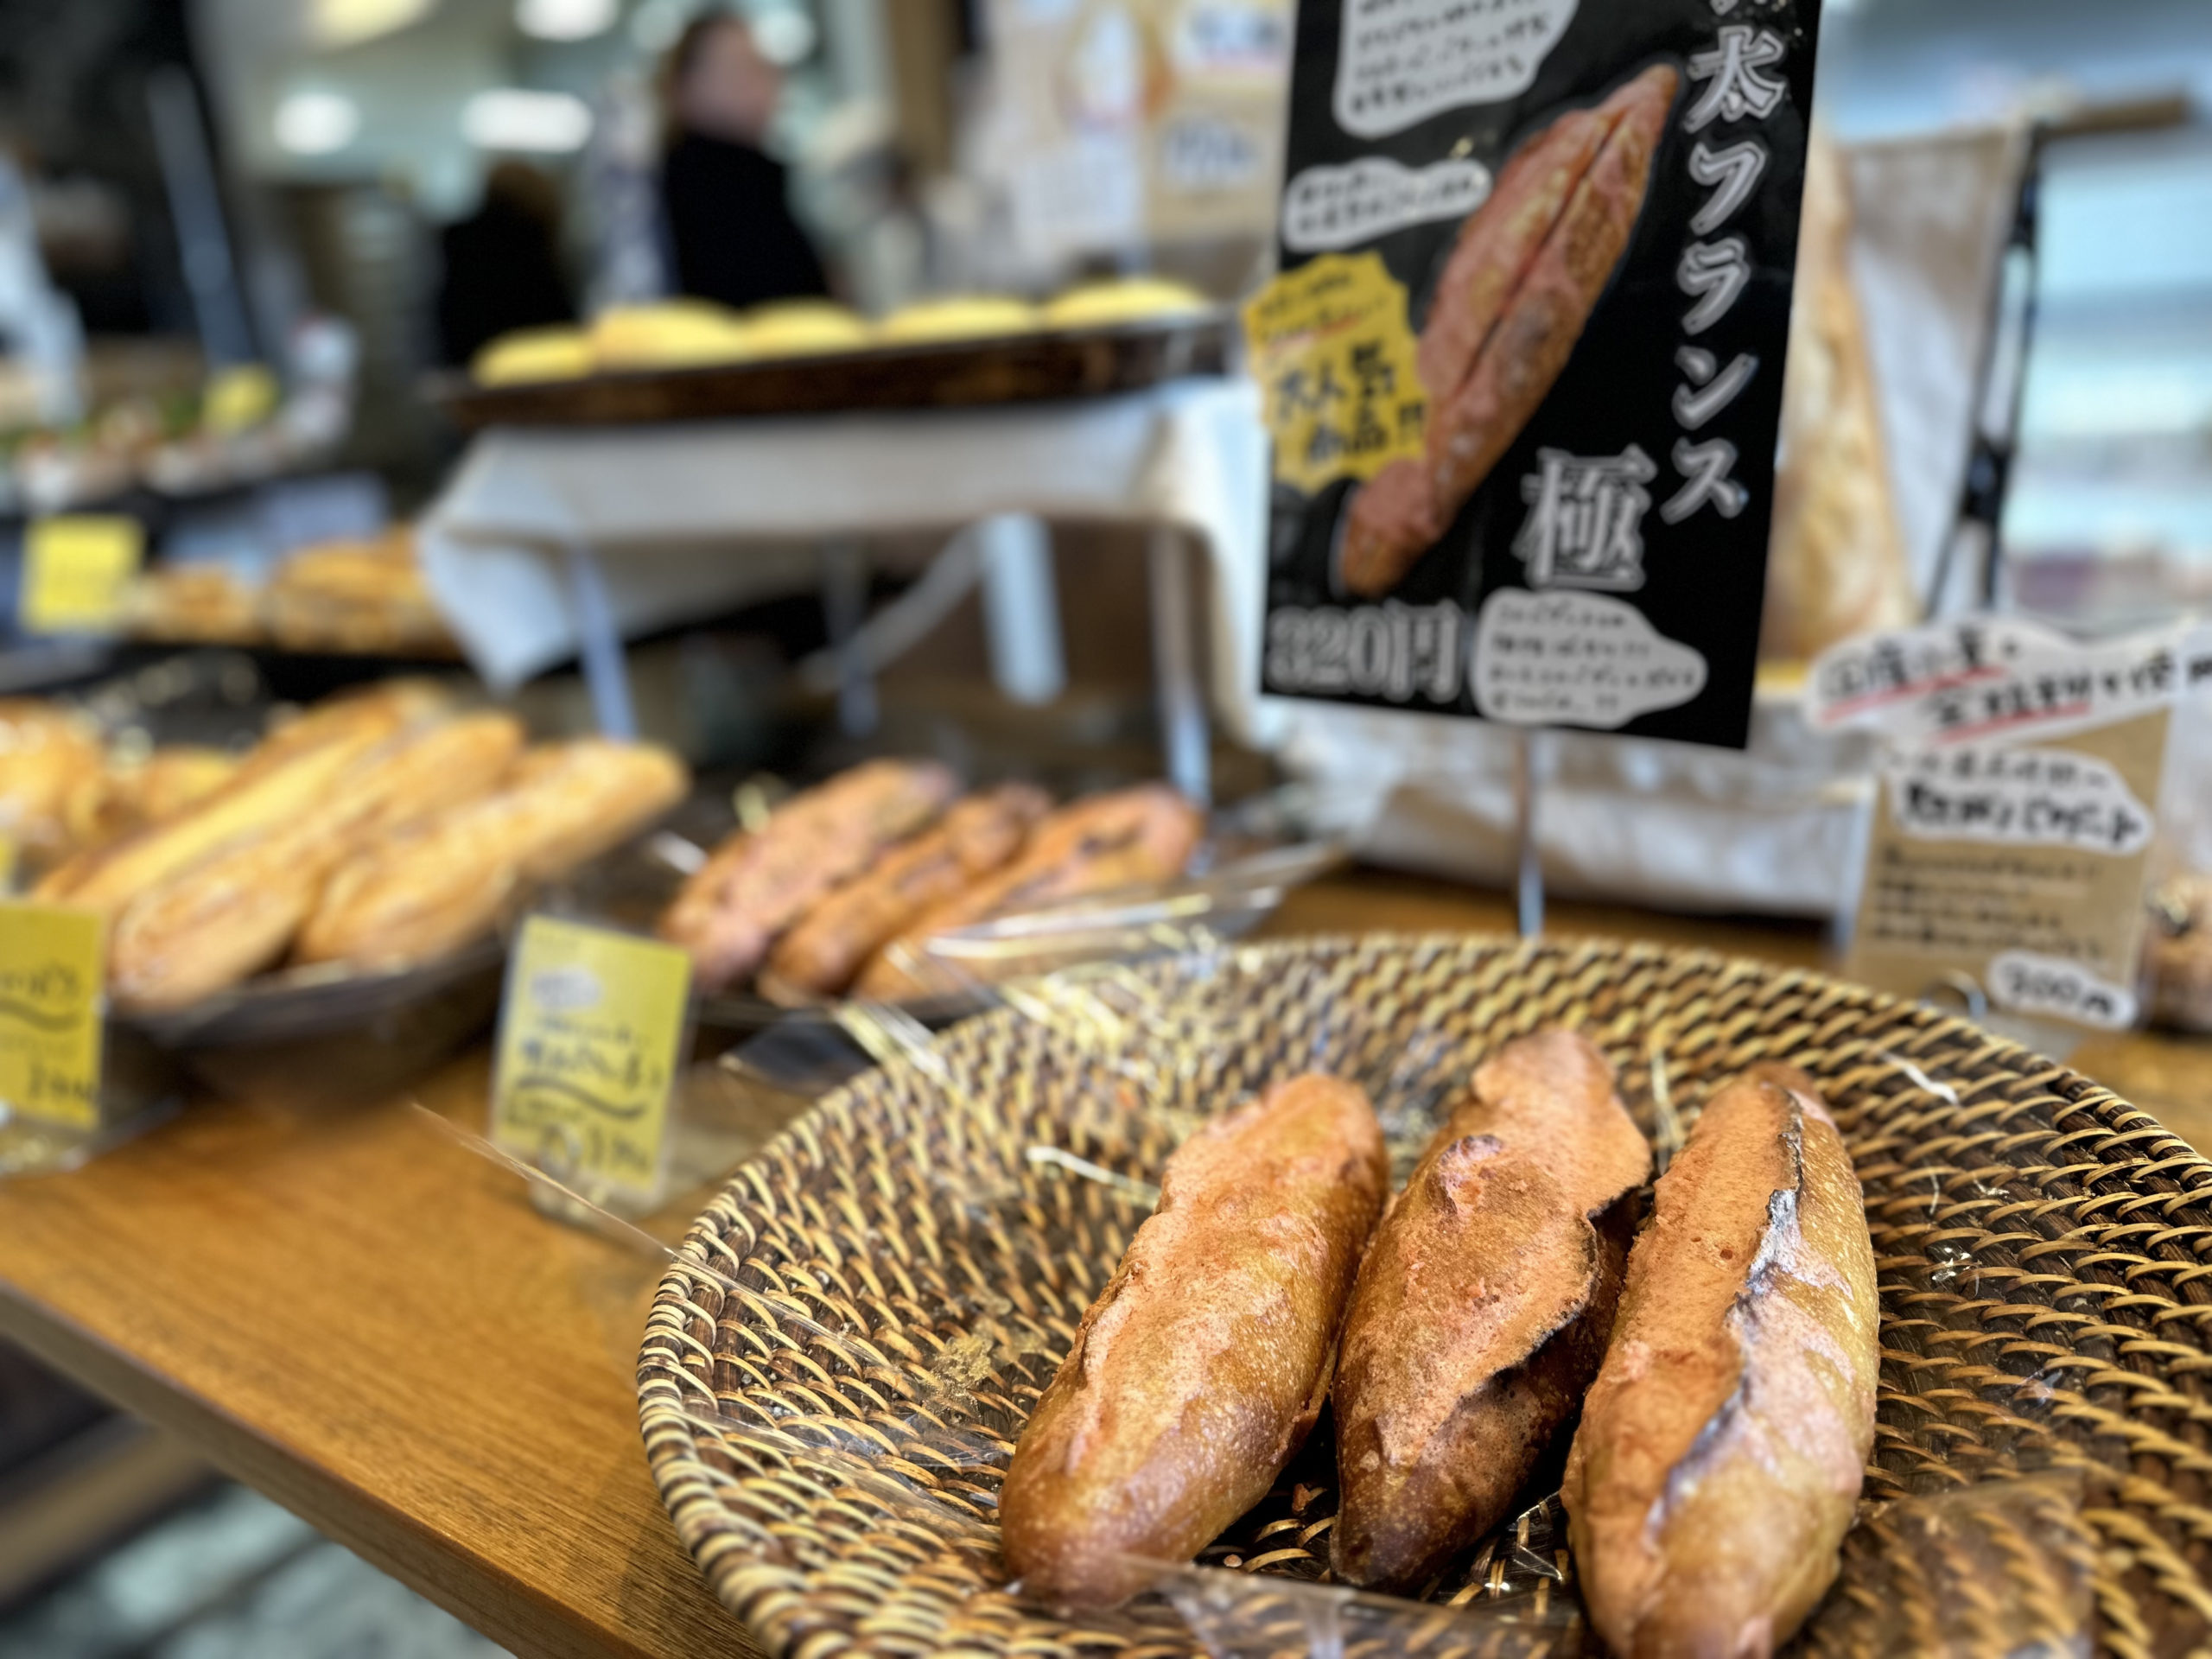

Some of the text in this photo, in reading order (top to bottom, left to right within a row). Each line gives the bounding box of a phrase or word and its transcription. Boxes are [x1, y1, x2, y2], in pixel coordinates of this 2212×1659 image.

[1660, 0, 1787, 524] 太フランス
[1518, 447, 1656, 591] 極
[1268, 599, 1459, 702] 320円
